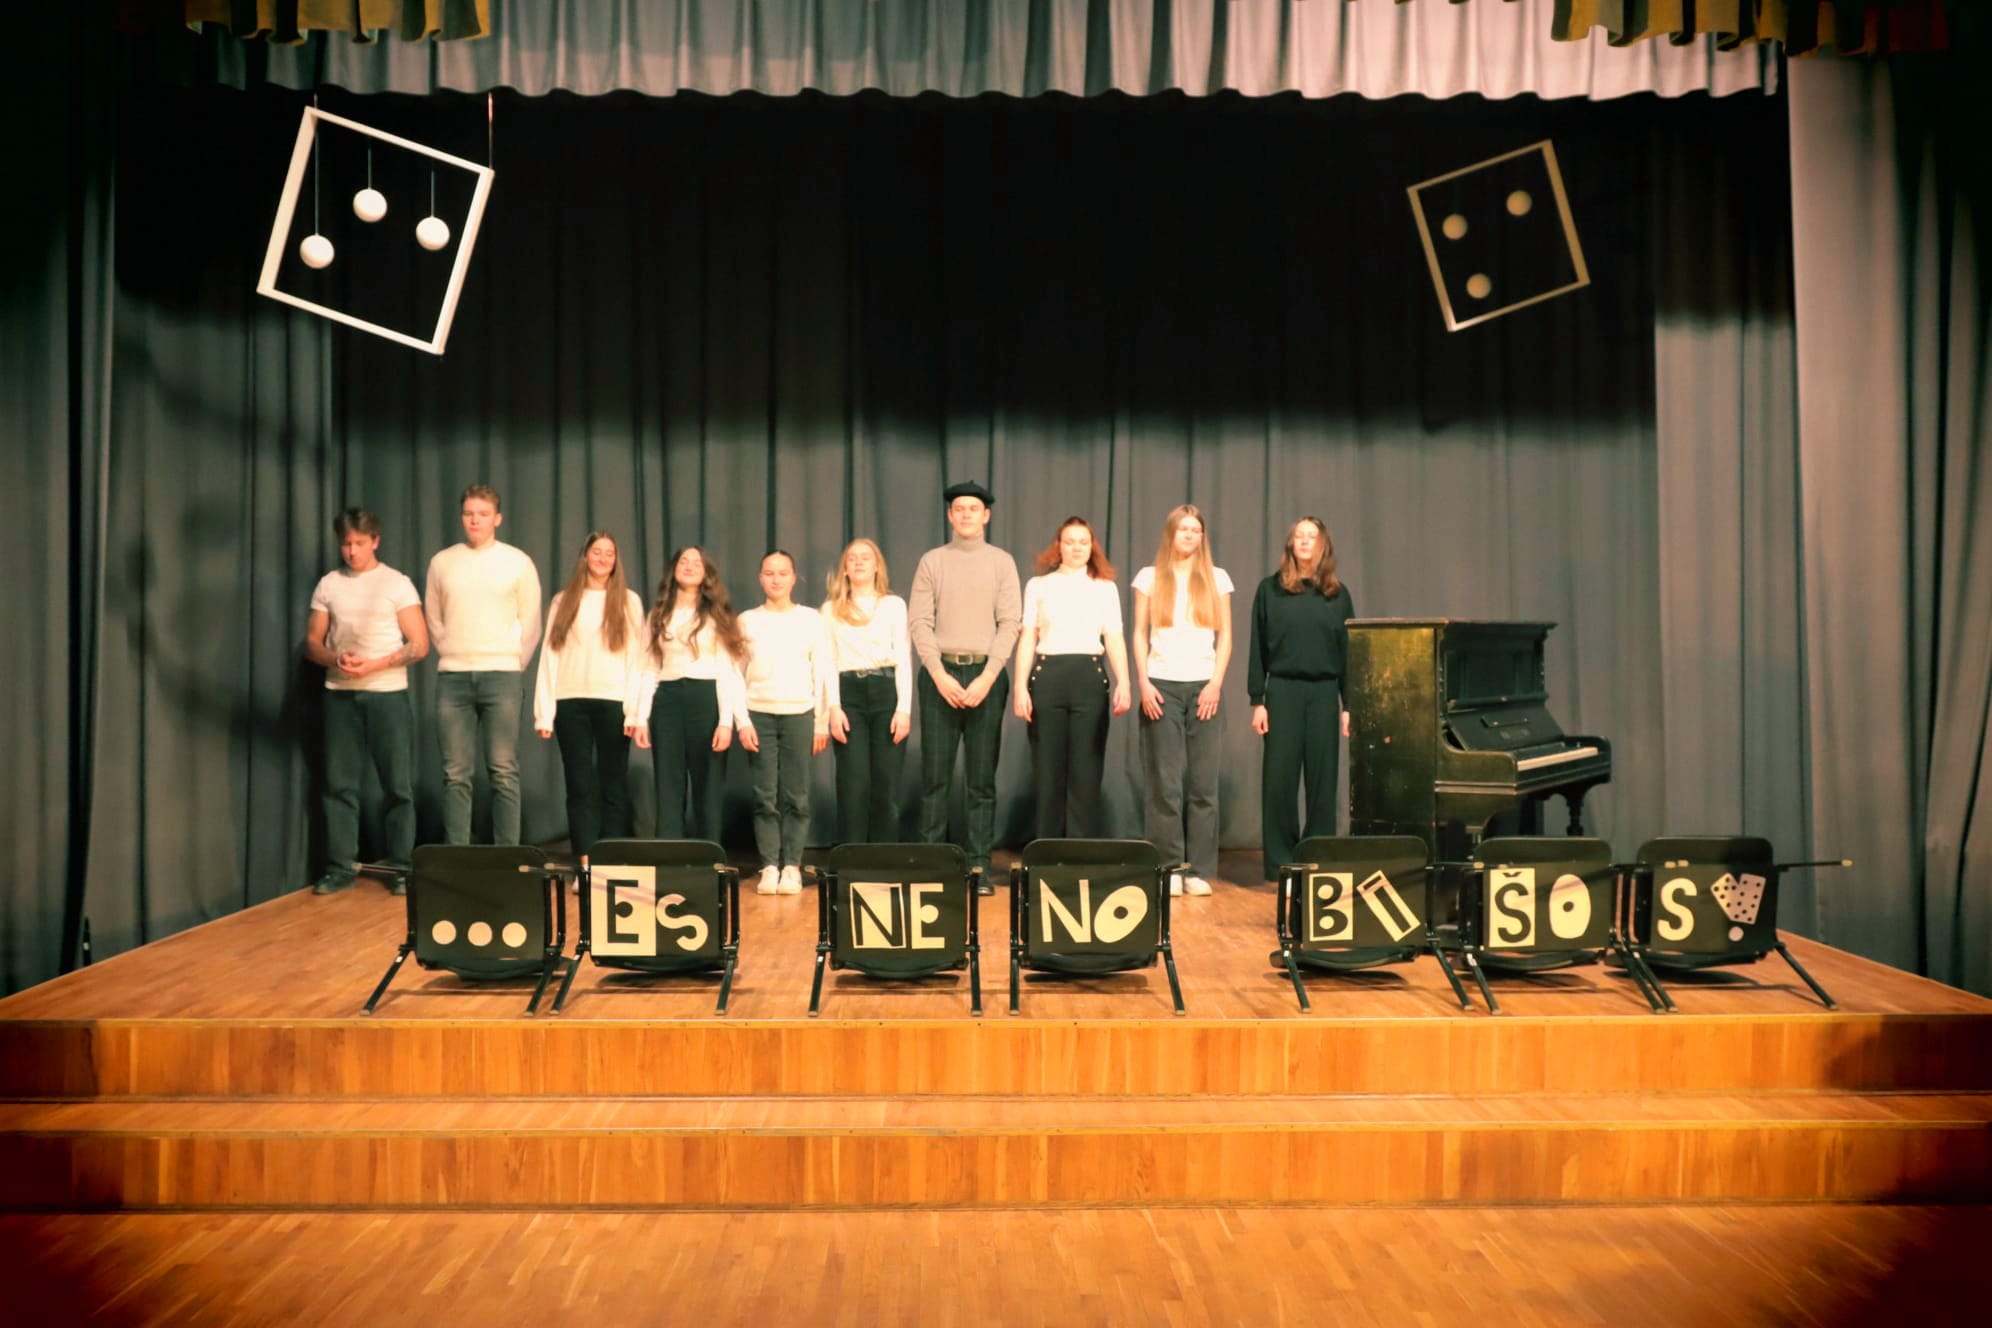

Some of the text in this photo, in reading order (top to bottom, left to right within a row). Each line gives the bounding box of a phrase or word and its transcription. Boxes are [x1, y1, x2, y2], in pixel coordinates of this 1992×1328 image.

[850, 882, 945, 949] NE
[1039, 879, 1148, 943] NO
[1493, 871, 1591, 943] ŠO
